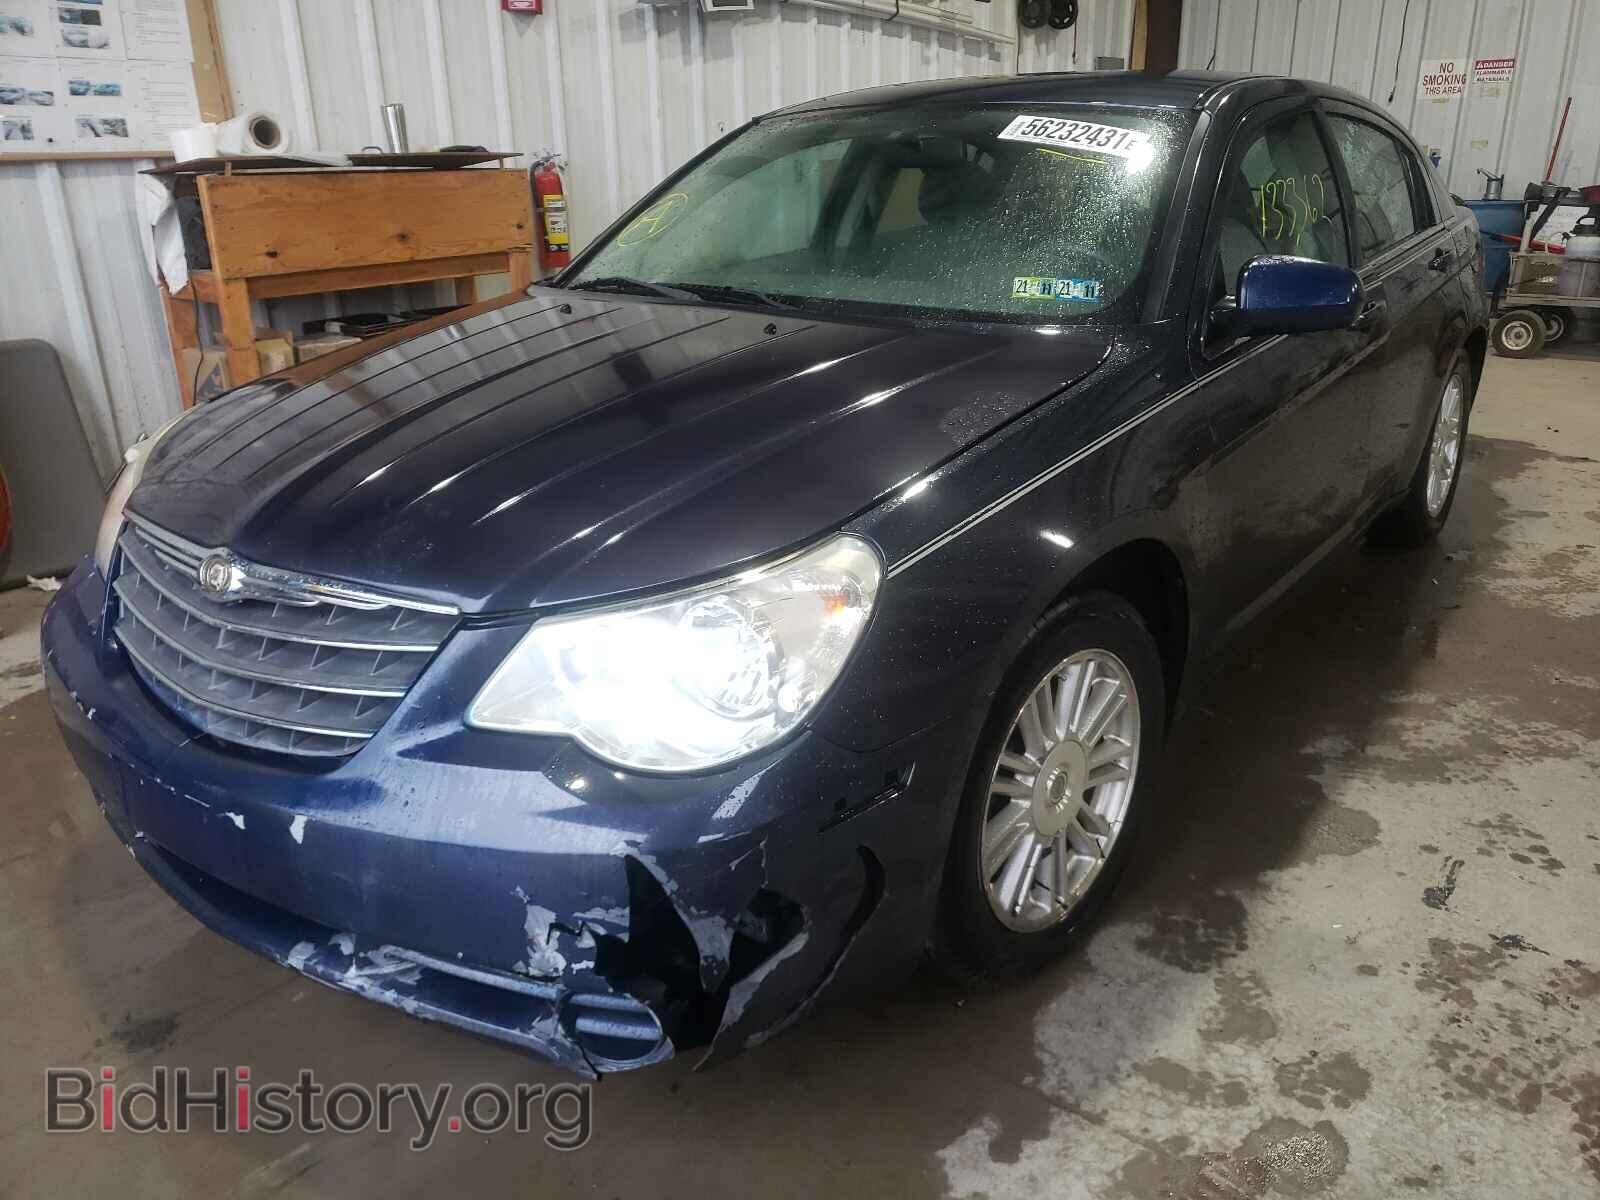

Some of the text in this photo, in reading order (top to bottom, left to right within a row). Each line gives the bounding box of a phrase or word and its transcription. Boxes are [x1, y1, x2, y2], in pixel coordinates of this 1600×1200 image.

[1439, 62, 1455, 74] NO
[1483, 61, 1513, 69] DANGER
[1422, 73, 1467, 87] SMOKING
[1425, 86, 1462, 95] THIS AREA
[1021, 119, 1131, 150] 56232431
[1016, 279, 1052, 296] 21 11
[1060, 281, 1095, 298] 21 11
